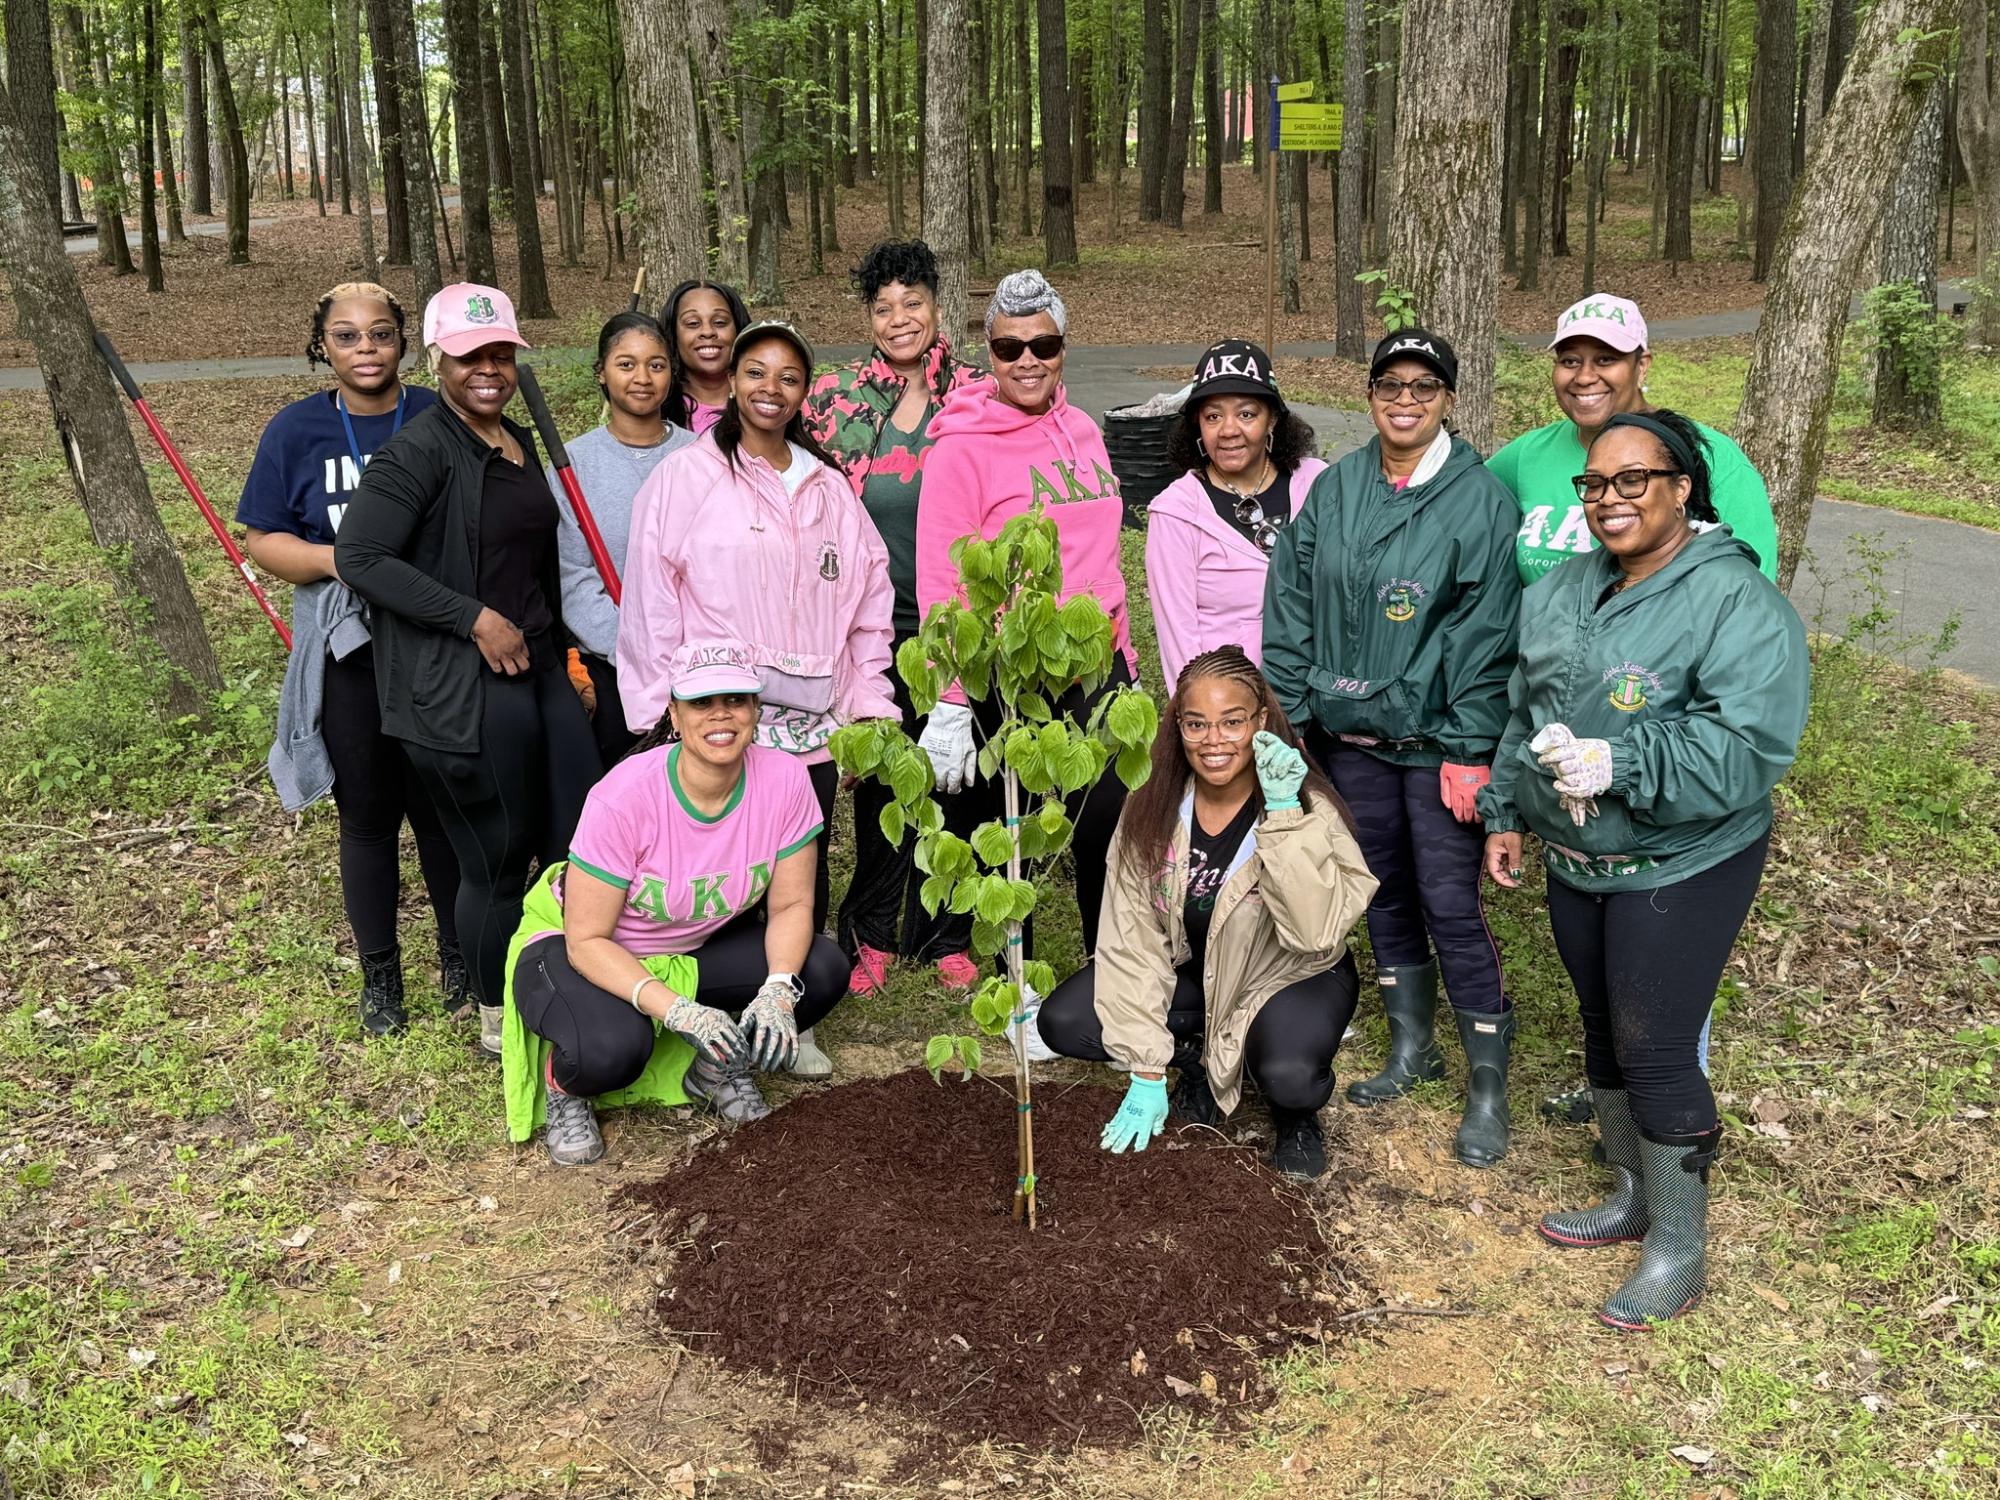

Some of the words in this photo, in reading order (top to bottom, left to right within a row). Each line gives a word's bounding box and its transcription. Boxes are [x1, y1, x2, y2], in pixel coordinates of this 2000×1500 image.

[1562, 302, 1626, 330] AKA
[1388, 338, 1436, 355] AKA
[1200, 354, 1263, 383] AKA
[1028, 458, 1121, 512] AKA
[1517, 505, 1594, 553] AK
[686, 645, 747, 673] AKA
[781, 657, 801, 668] 1908
[1331, 678, 1370, 694] 1908
[627, 858, 772, 922] AKA
